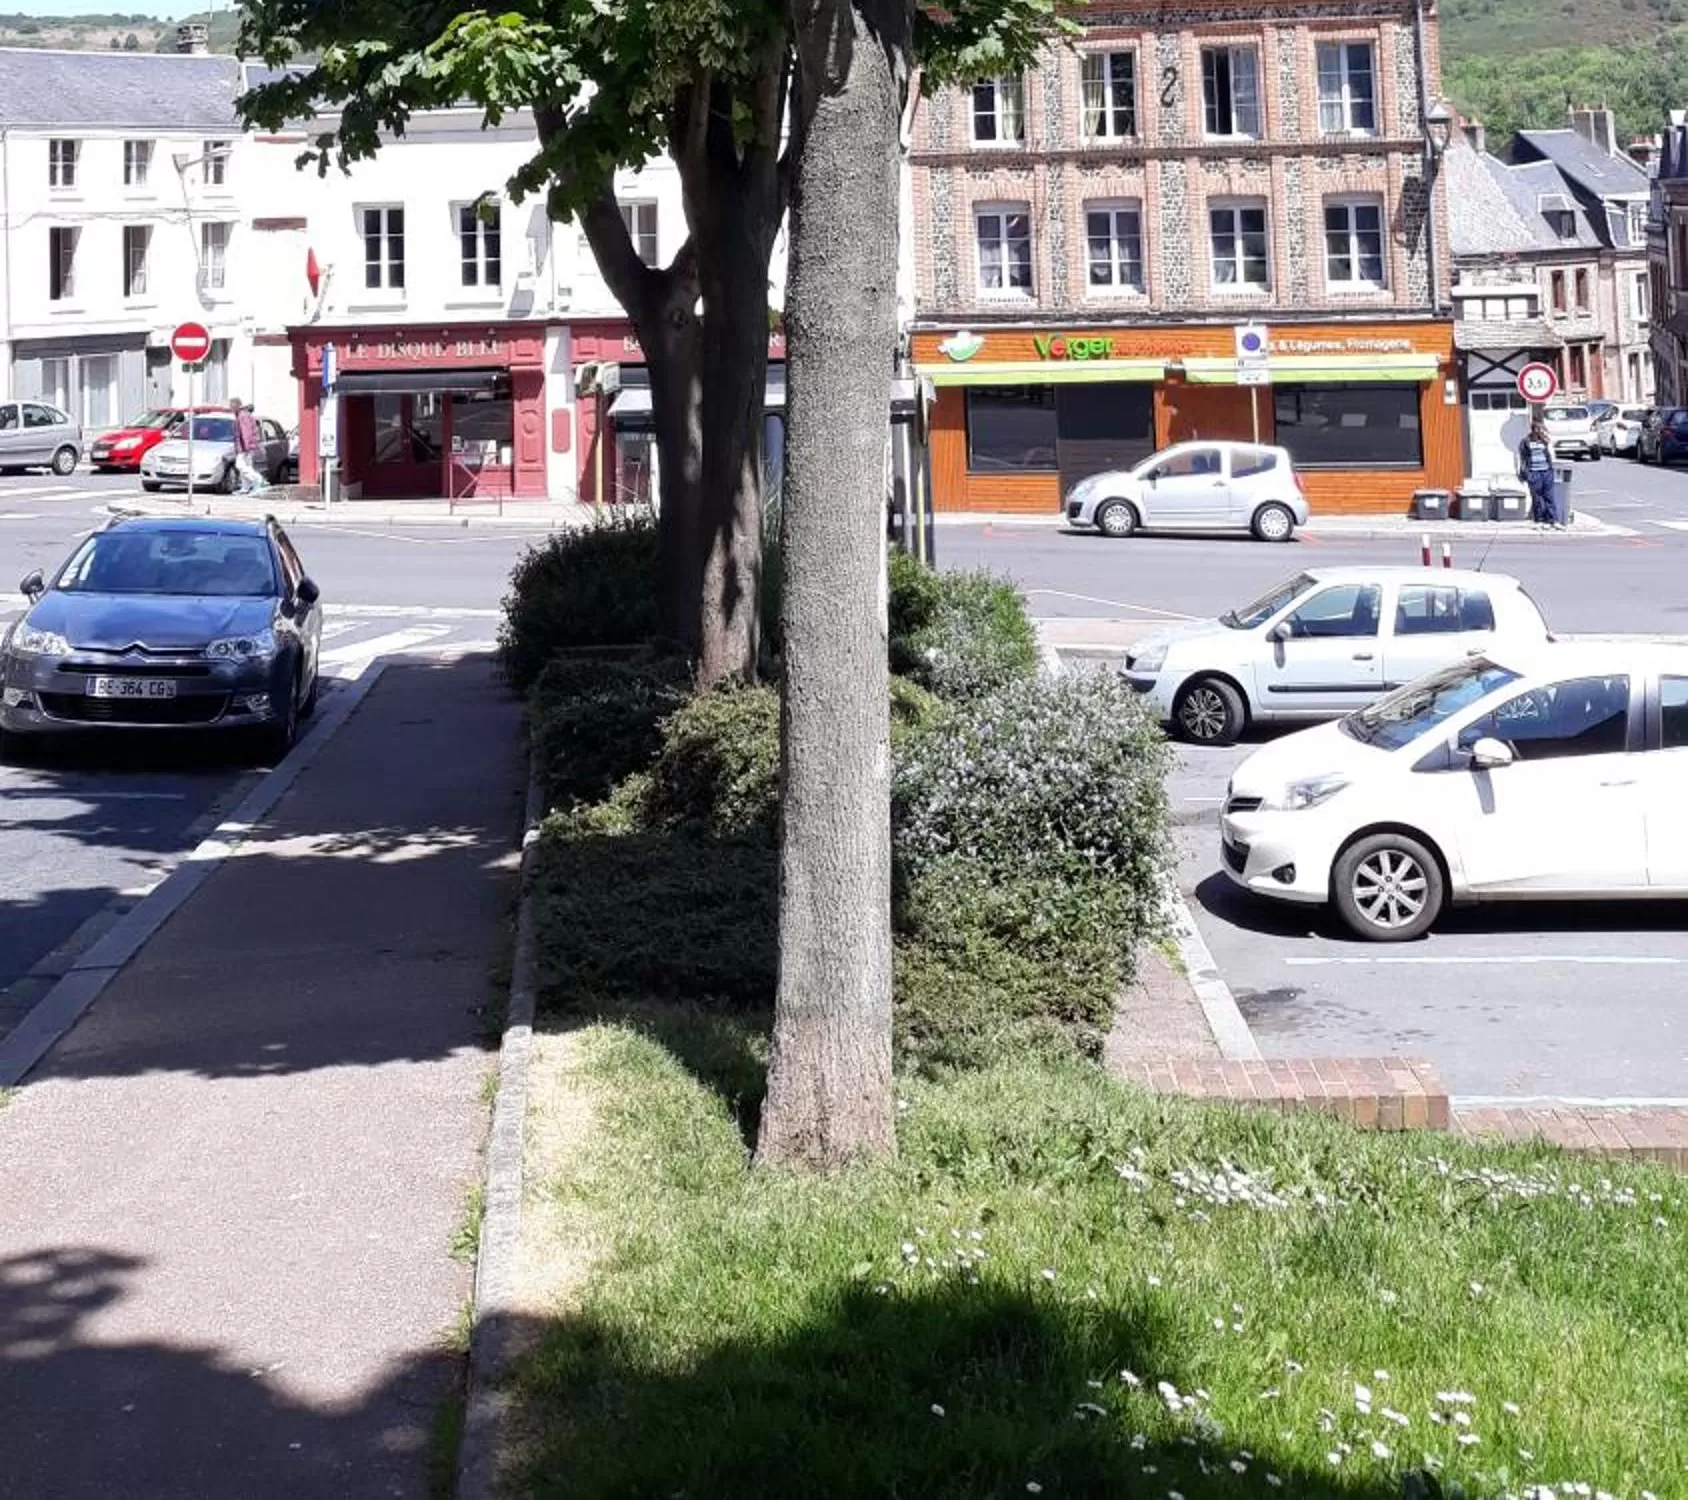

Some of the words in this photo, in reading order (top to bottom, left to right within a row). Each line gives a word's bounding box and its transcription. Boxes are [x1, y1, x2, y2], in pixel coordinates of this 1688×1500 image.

[345, 342, 367, 359] LE
[376, 341, 447, 360] DISQUE
[455, 339, 500, 357] BLEU
[1034, 333, 1113, 360] Verger
